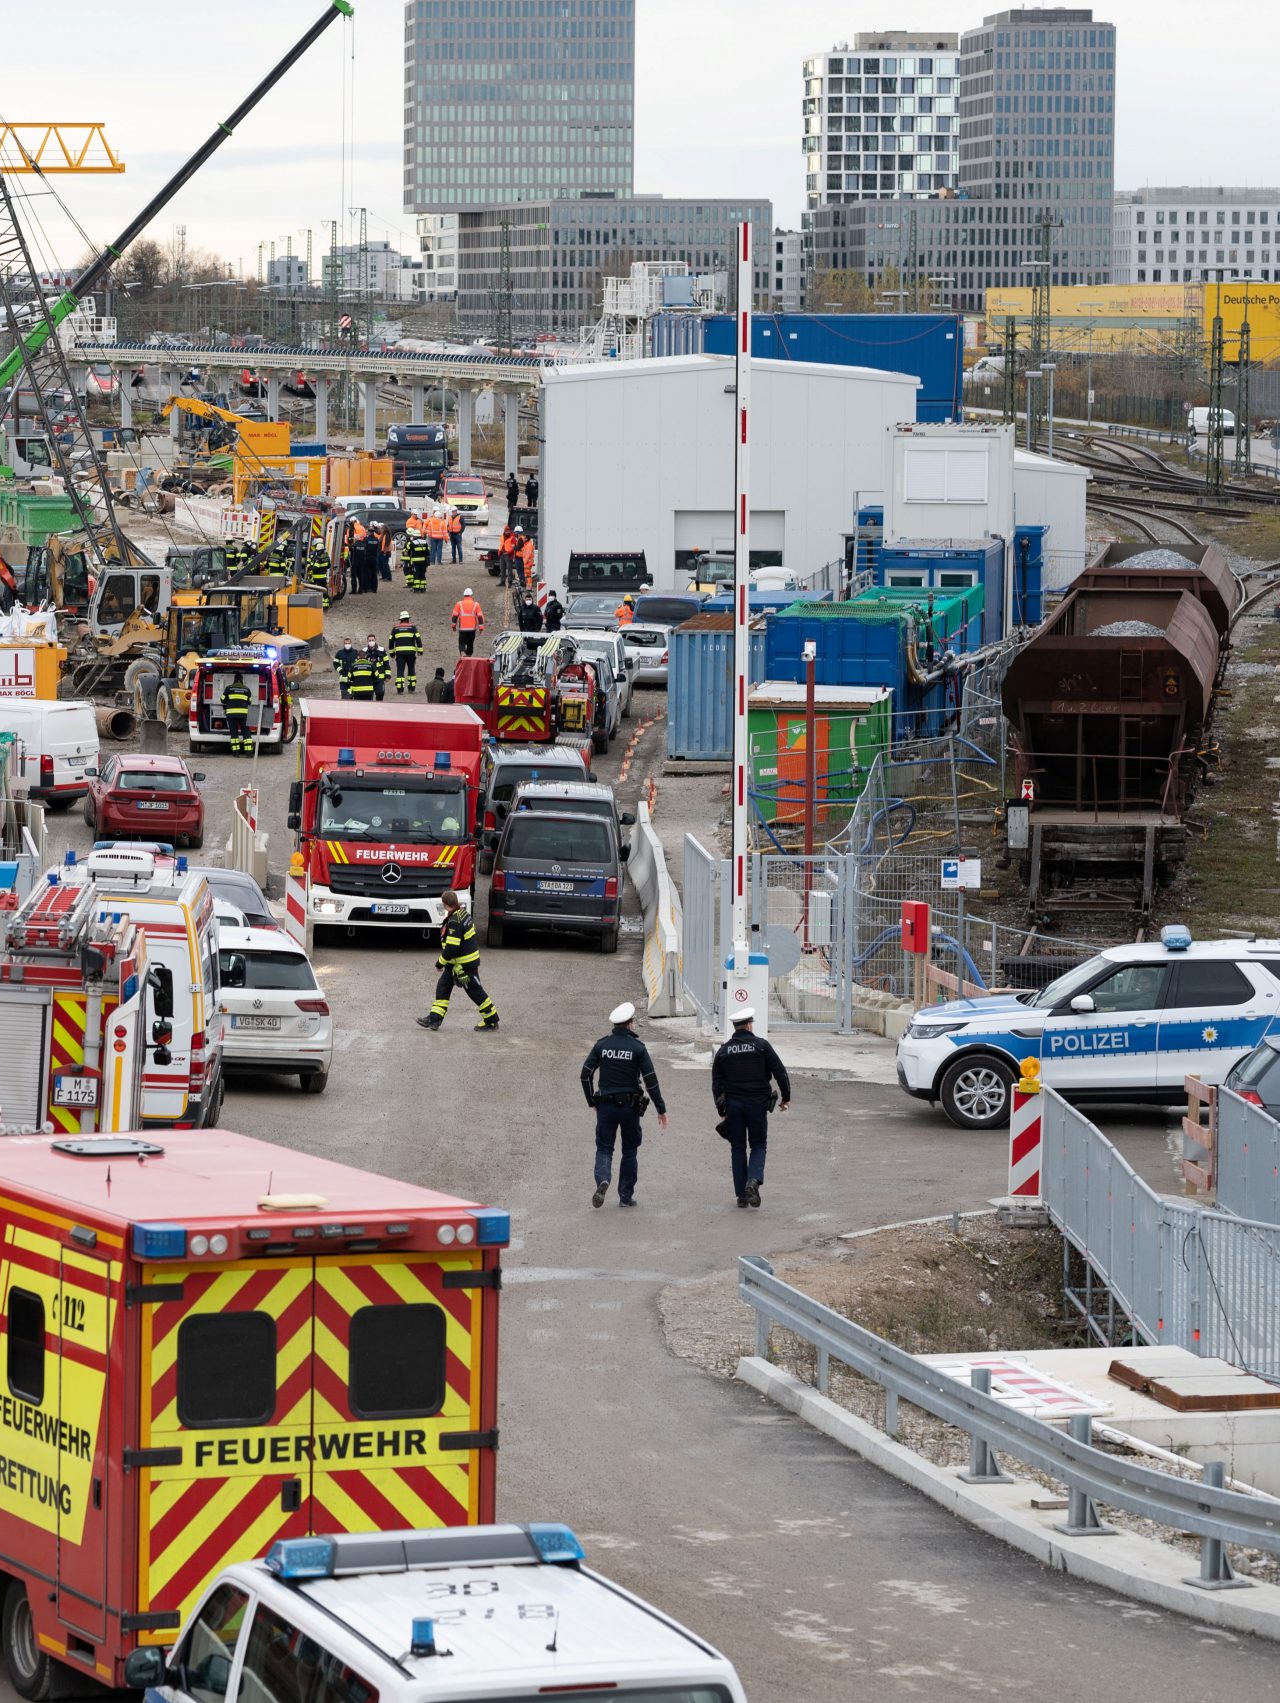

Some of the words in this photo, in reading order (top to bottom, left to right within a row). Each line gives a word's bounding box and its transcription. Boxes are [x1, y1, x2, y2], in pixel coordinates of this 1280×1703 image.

[1223, 294, 1267, 305] Deutsche
[15, 689, 36, 697] BÖGL
[356, 849, 429, 861] FEUERWEHR
[239, 1017, 250, 1026] VG
[255, 1017, 266, 1027] SK
[267, 1018, 278, 1027] 40
[1050, 1031, 1130, 1052] POLIZEI
[727, 1042, 755, 1055] POLIZEI
[601, 1049, 633, 1061] POLIZEI
[74, 1079, 82, 1090] M
[56, 1088, 65, 1100] F
[66, 1090, 95, 1103] 1175
[62, 1295, 86, 1332] 112
[195, 1428, 427, 1468] FEUERWEHR
